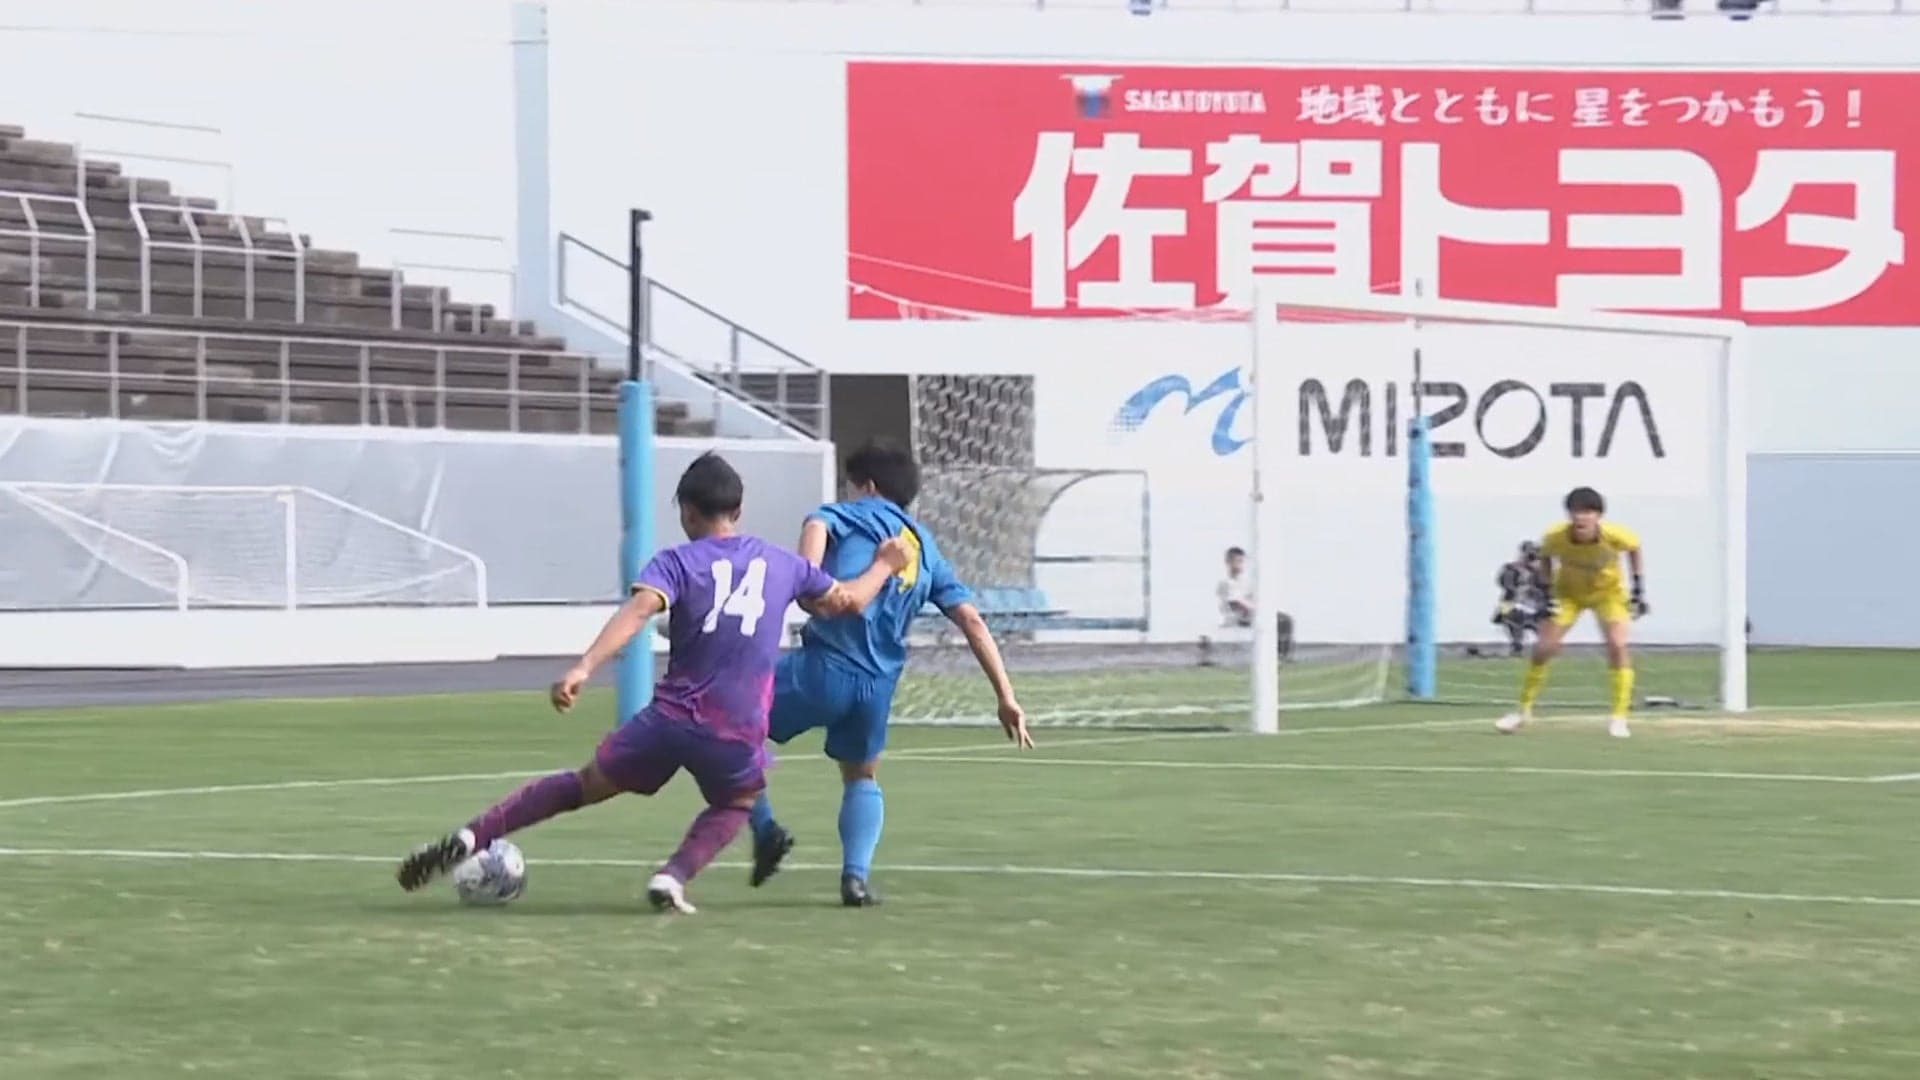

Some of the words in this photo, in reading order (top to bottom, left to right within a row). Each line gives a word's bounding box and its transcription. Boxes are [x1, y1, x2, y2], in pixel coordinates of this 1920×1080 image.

[1124, 89, 1266, 113] SAGATOYOTA
[1296, 84, 1555, 126] 地域とともに
[1012, 131, 1906, 312] 佐賀トヨタ
[1298, 378, 1666, 459] MIZOTA
[702, 558, 767, 637] 14
